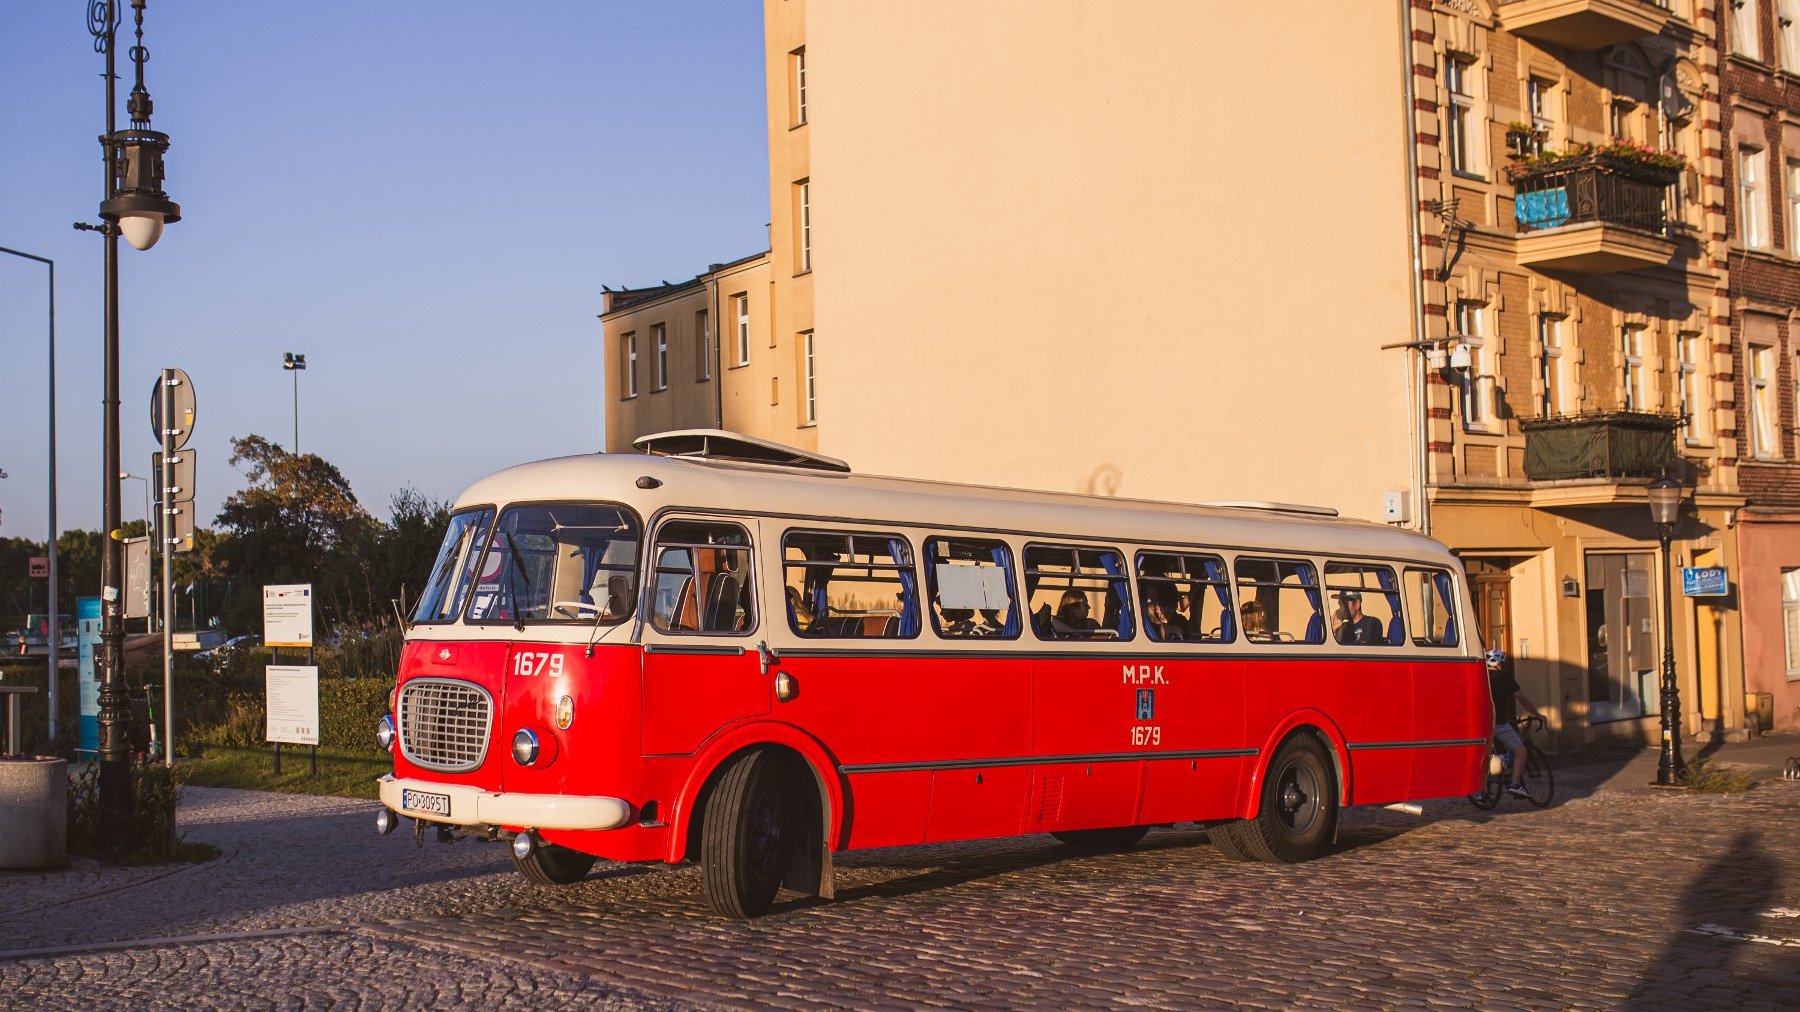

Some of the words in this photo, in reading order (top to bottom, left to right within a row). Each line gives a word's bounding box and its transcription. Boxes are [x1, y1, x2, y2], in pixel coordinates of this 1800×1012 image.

[513, 651, 565, 678] 1679
[1122, 665, 1169, 684] M.P.K.
[1130, 726, 1160, 746] 1679
[407, 792, 418, 808] PO
[420, 794, 447, 812] 3095T
